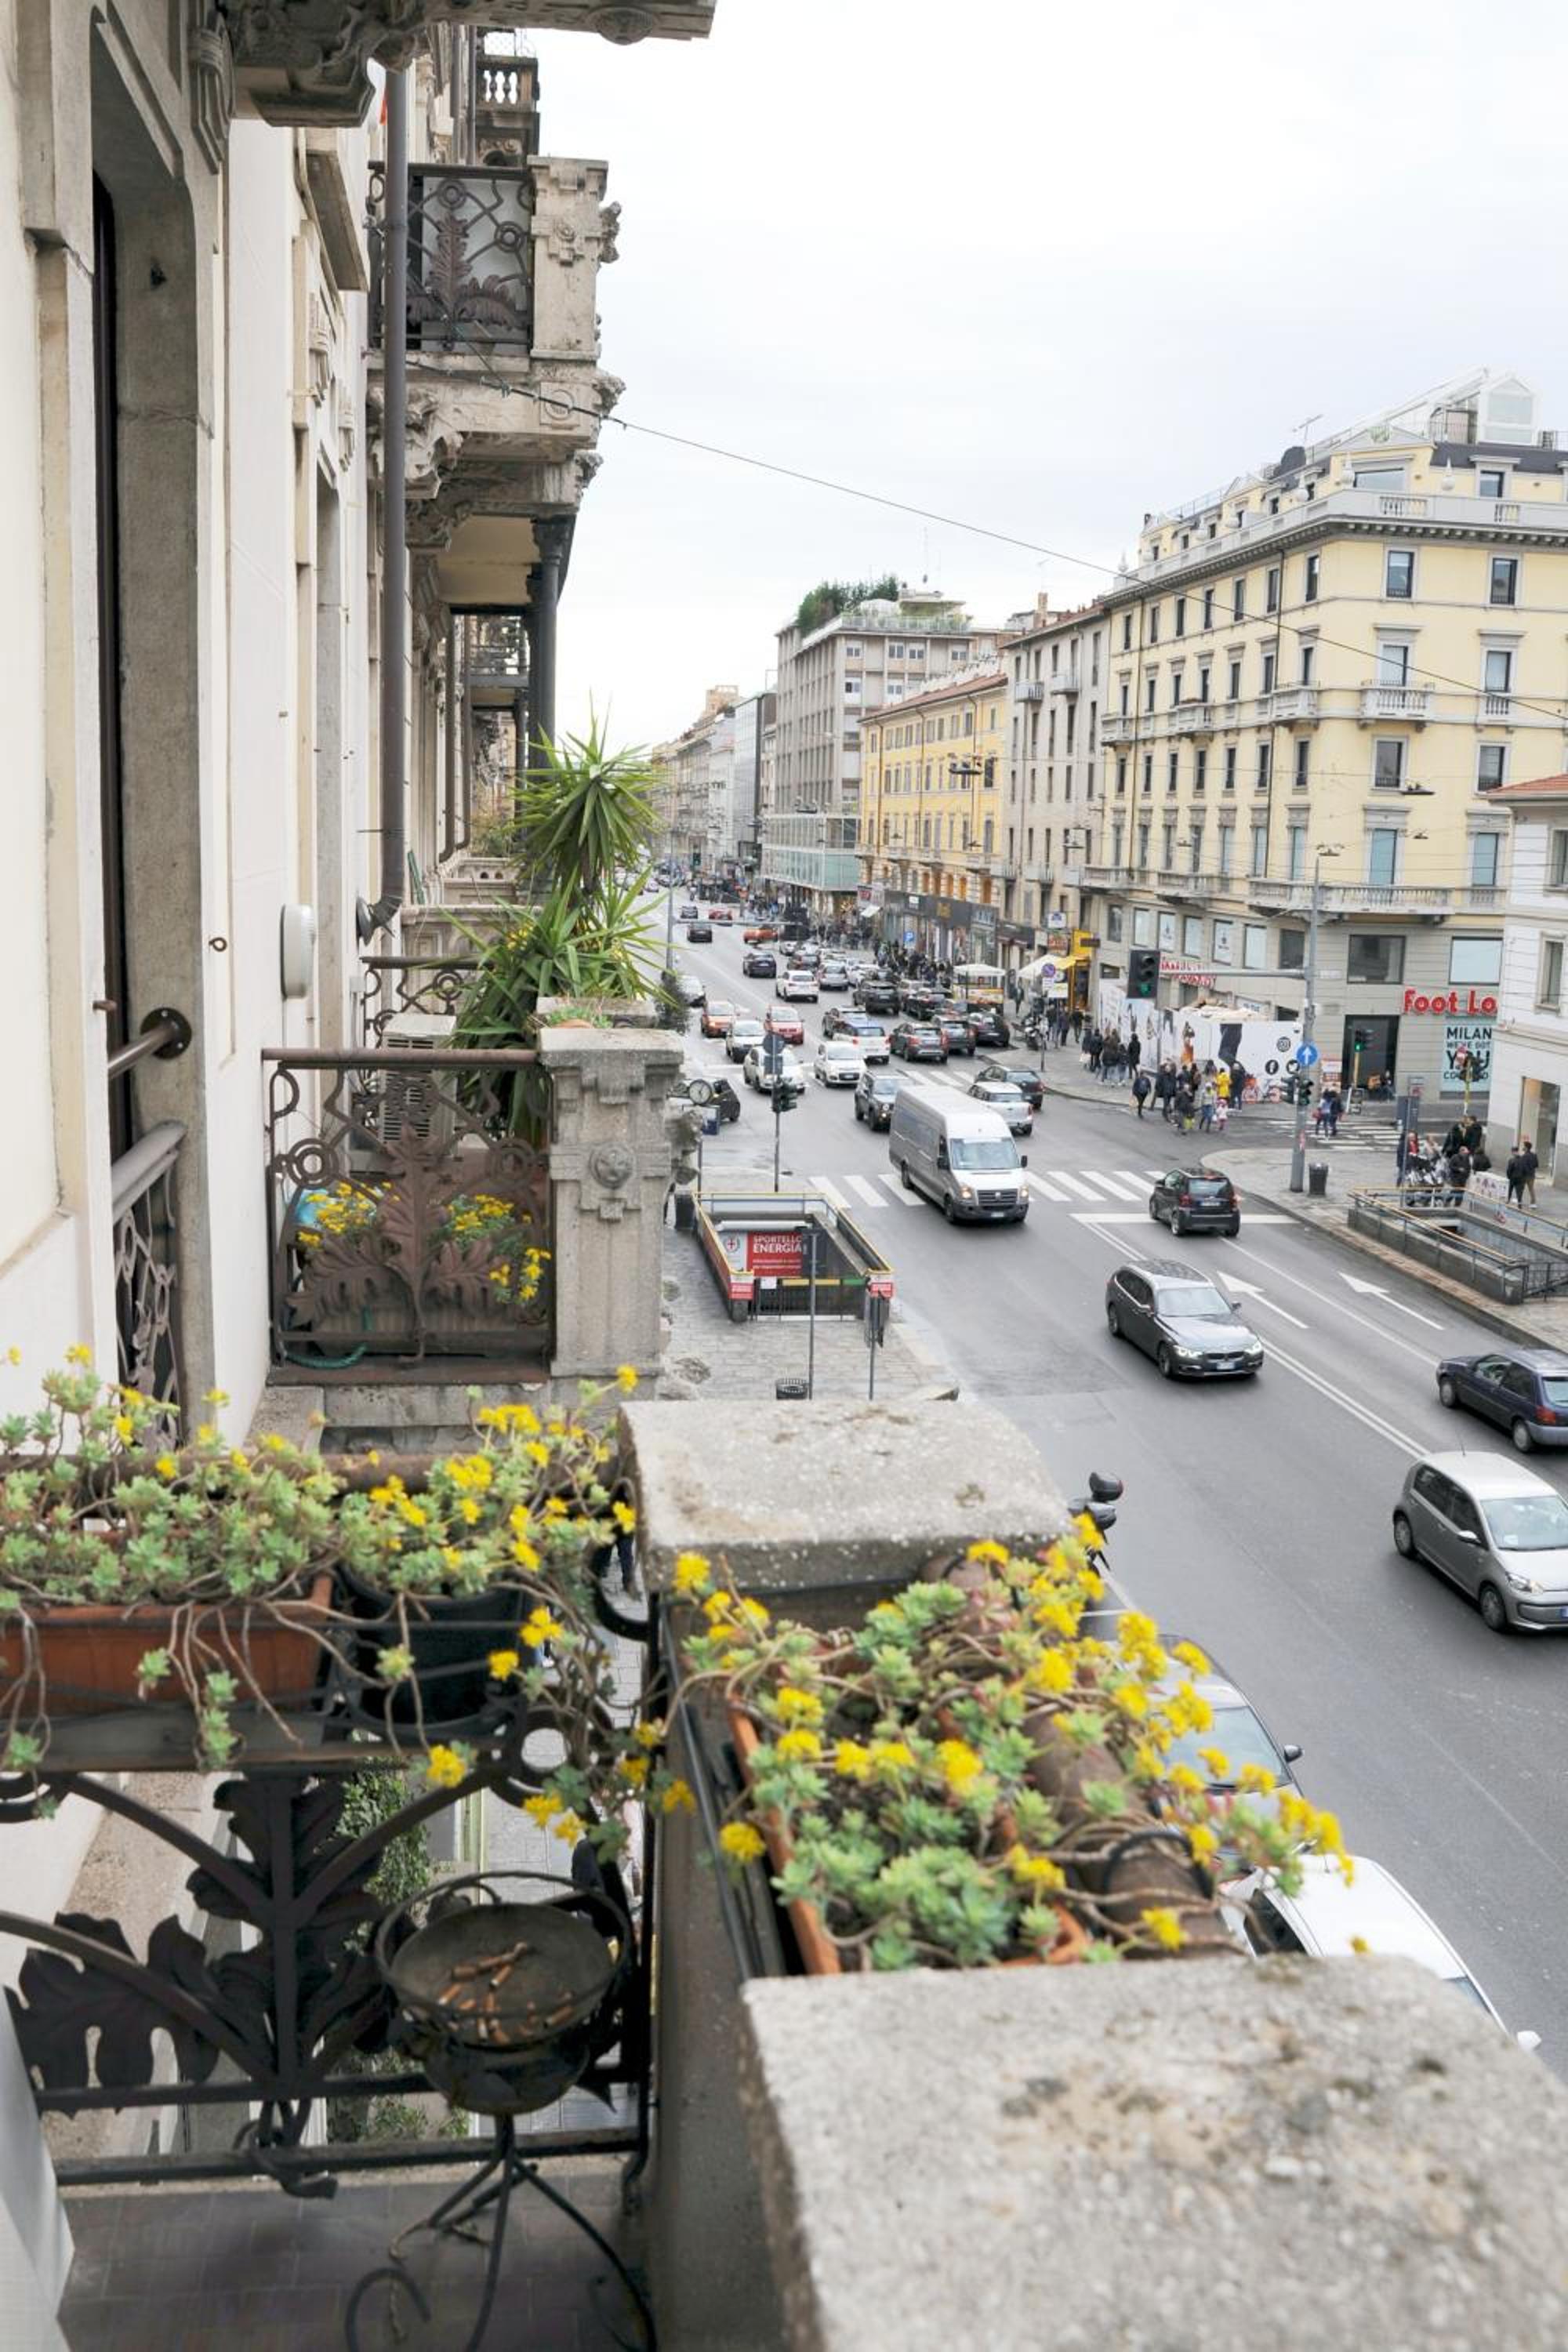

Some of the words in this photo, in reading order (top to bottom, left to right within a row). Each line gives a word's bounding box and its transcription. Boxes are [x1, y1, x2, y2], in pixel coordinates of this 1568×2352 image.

[1404, 989, 1457, 1014] Foot
[1446, 1027, 1492, 1040] MILAN
[1446, 1051, 1490, 1069] YU
[753, 1243, 803, 1254] ENERGIA
